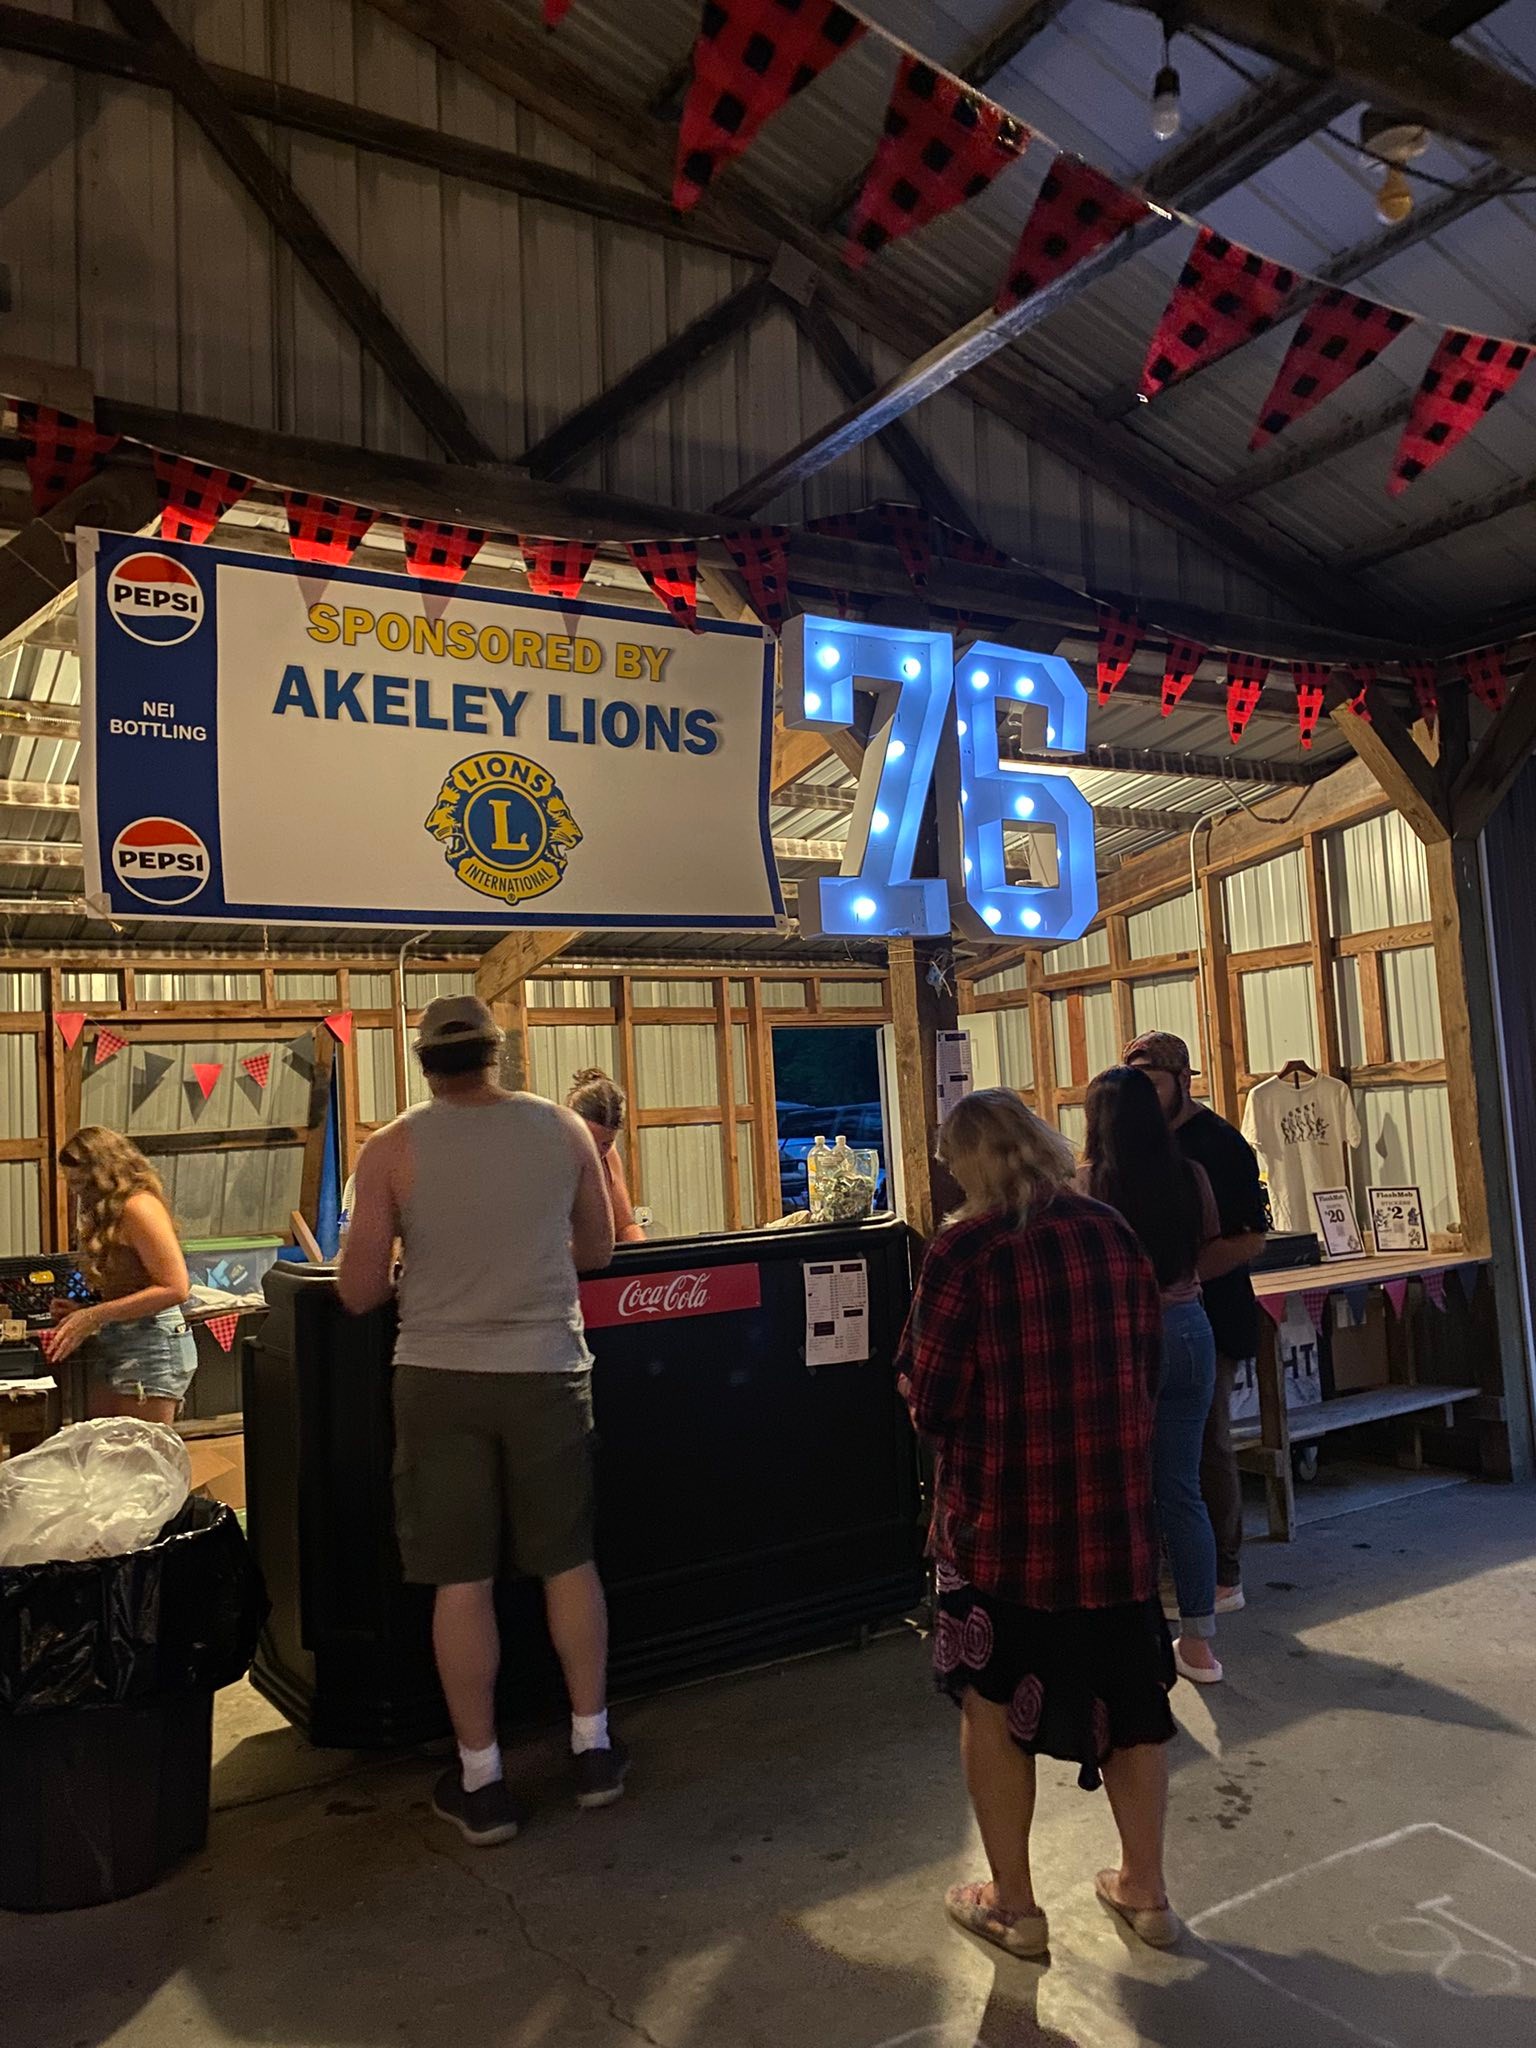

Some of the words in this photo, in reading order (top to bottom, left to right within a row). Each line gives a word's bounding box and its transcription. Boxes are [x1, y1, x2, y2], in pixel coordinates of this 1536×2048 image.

[113, 583, 198, 613] PEPSI
[305, 602, 602, 674] SPONSORED
[615, 641, 672, 682] BY
[142, 701, 175, 719] NEI
[272, 665, 529, 737] AKELEY
[547, 699, 720, 756] LIONS
[110, 719, 207, 741] BOTTLING
[459, 757, 547, 793] LIONS
[784, 613, 1099, 942] 76
[488, 799, 530, 851] L
[118, 850, 204, 872] PEPSI
[465, 863, 553, 893] INTERNATIONAL
